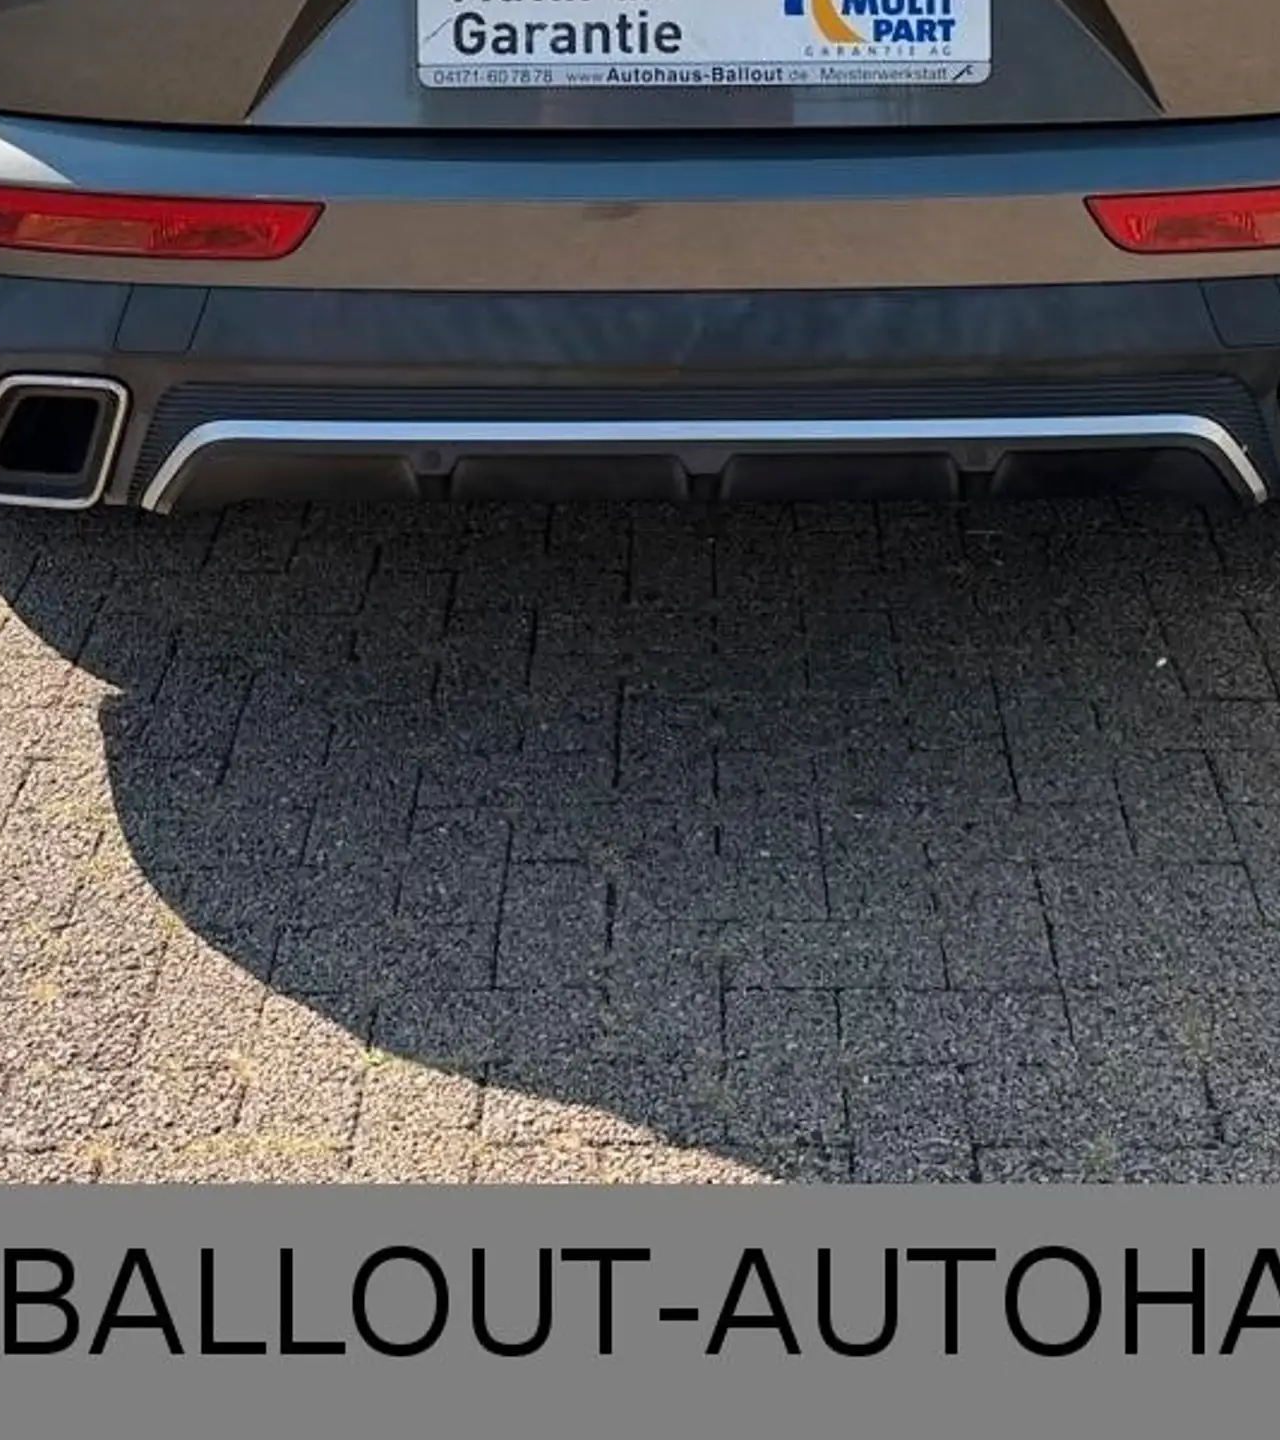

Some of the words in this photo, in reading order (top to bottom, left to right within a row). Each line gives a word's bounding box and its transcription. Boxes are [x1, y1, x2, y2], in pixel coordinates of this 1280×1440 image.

[452, 9, 683, 55] Garantie
[872, 18, 956, 43] PART
[804, 45, 916, 58] GARANTIE
[928, 45, 953, 58] AG
